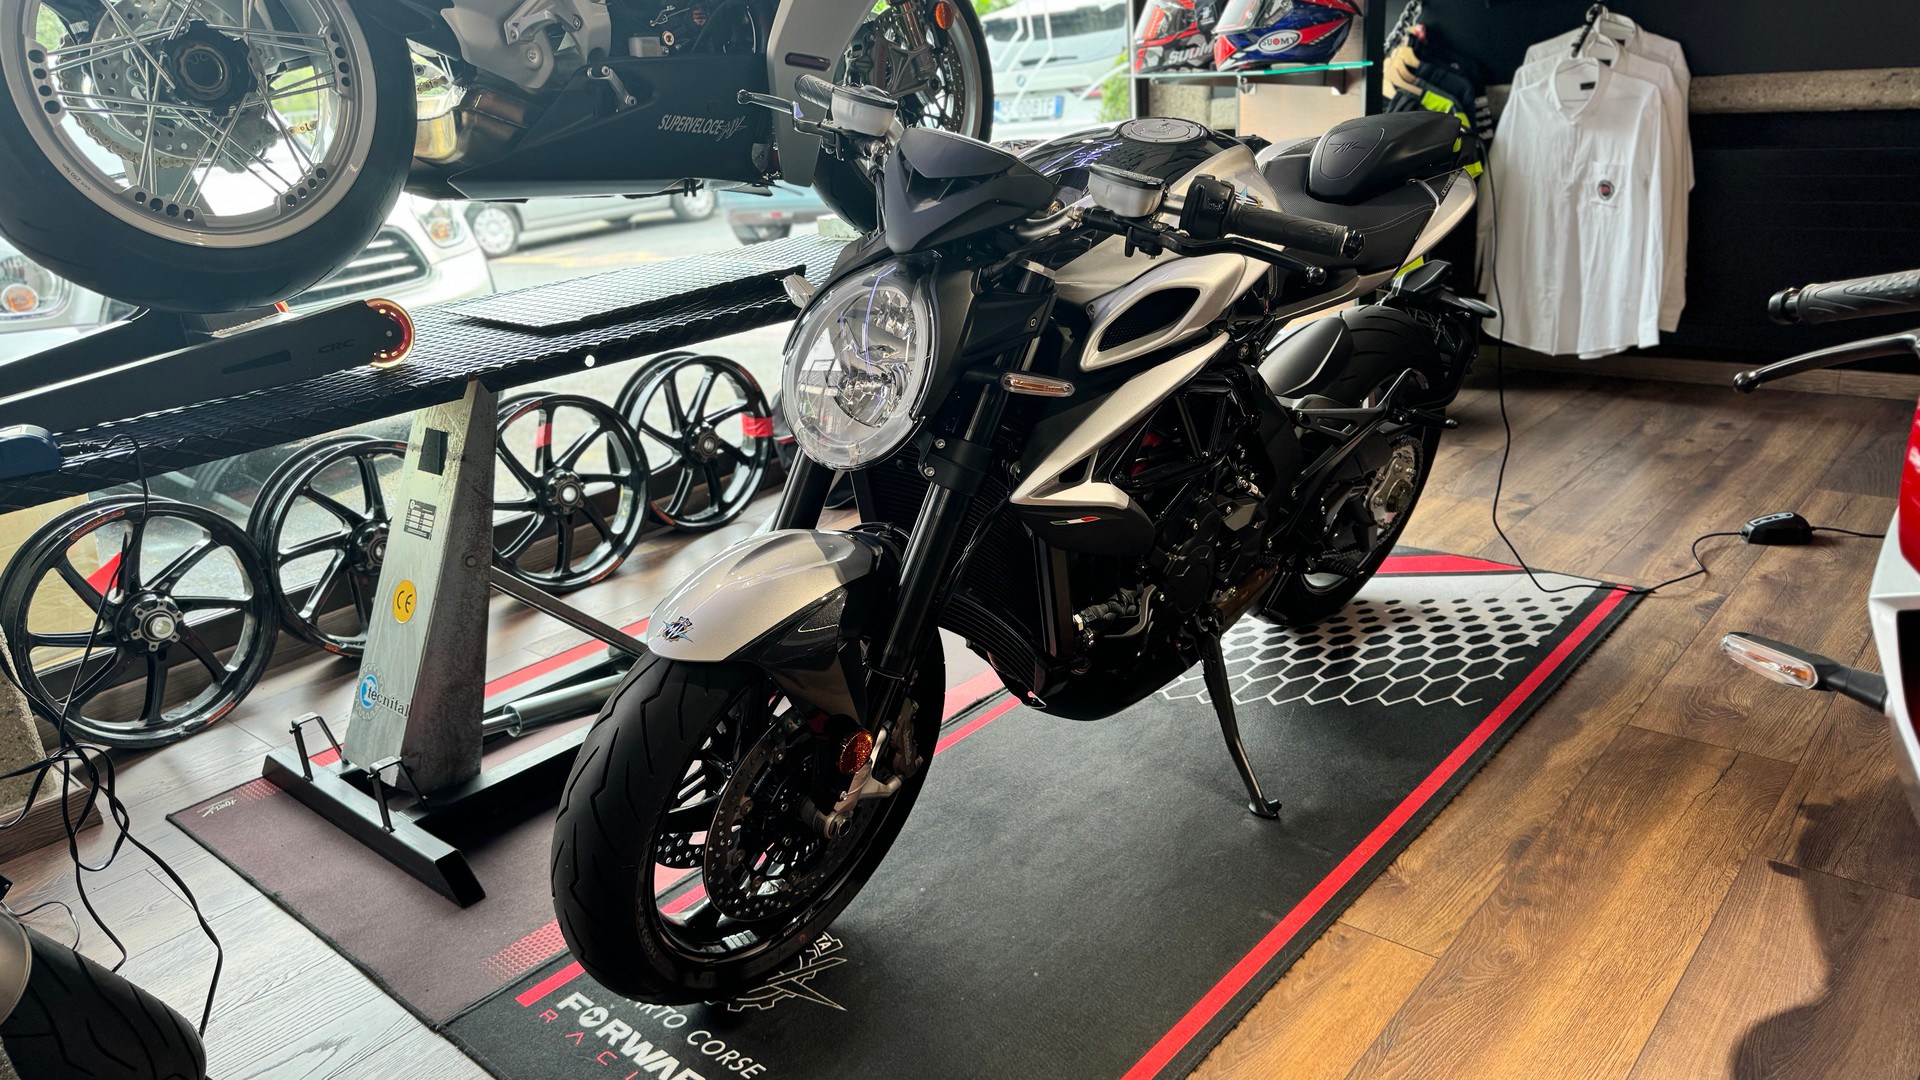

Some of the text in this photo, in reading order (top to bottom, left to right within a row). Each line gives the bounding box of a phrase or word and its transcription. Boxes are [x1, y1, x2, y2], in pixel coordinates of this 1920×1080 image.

[1261, 36, 1297, 47] SUOMY
[657, 114, 725, 135] SUPERVELOCE
[687, 1030, 768, 1080] CORSE
